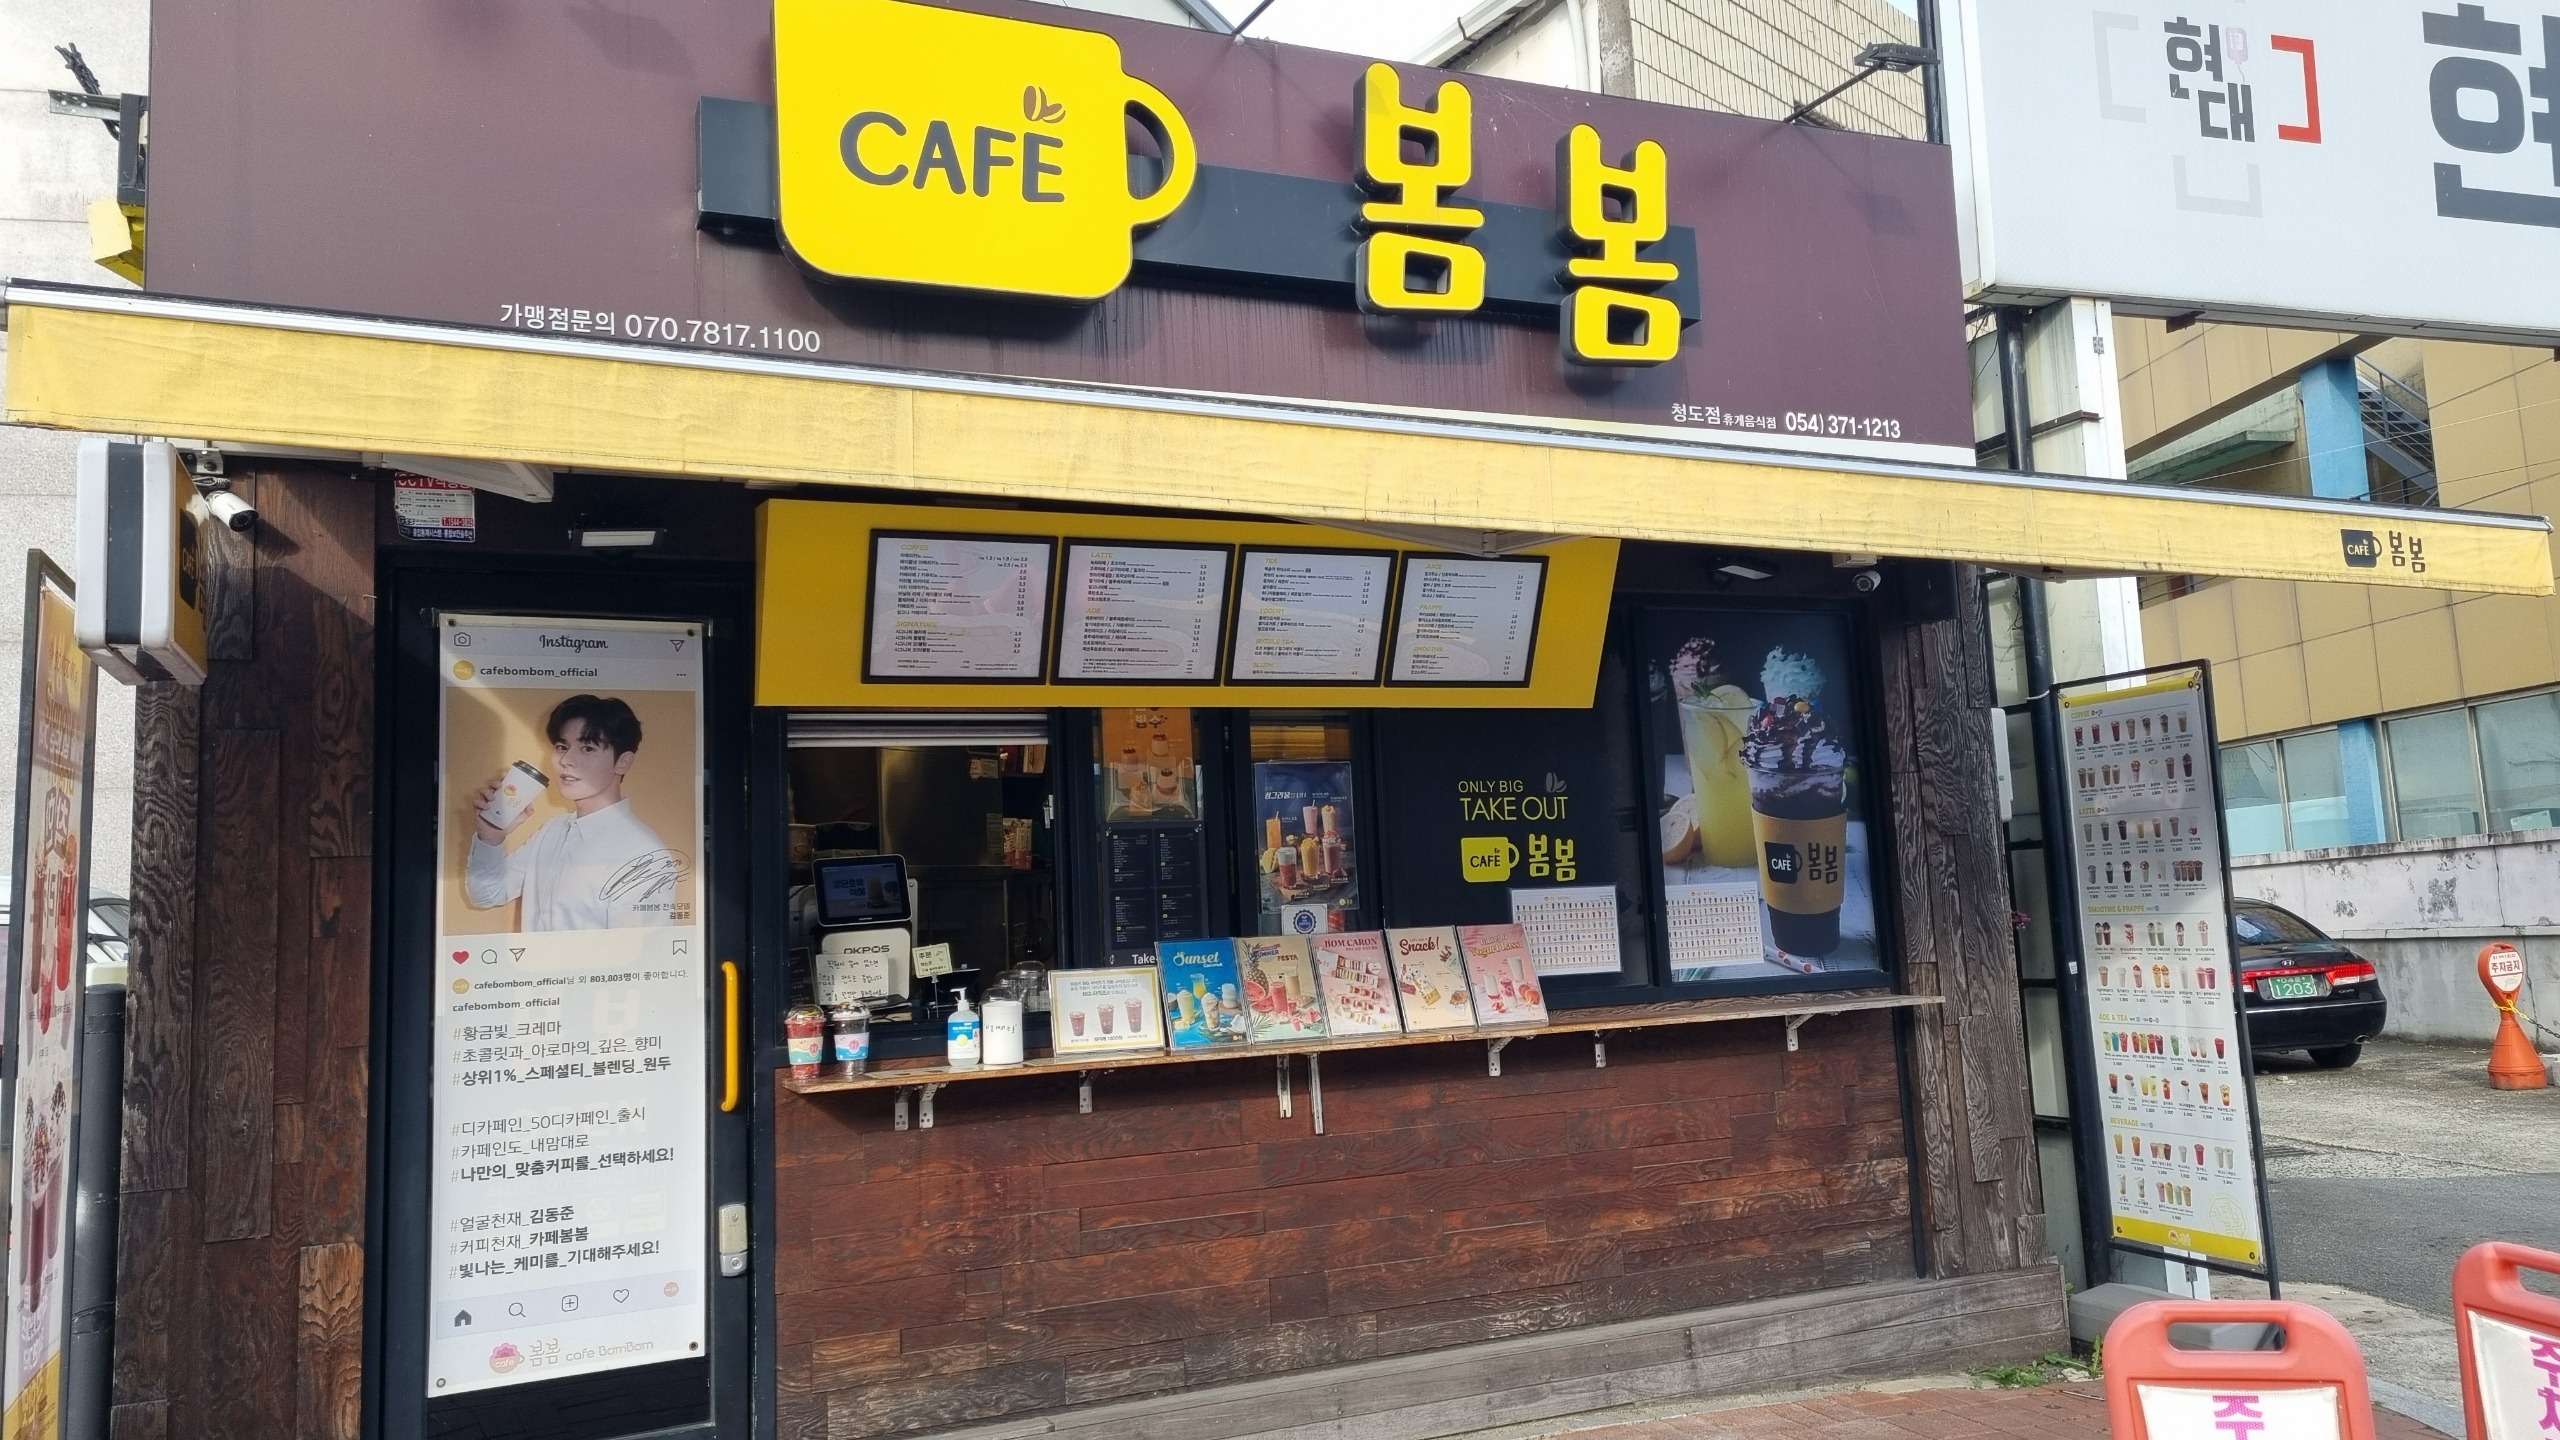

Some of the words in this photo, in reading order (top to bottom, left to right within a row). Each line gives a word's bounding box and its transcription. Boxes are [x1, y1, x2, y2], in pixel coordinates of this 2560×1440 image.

[2164, 16, 2255, 143] 현대
[839, 111, 1066, 203] CAFE
[1357, 61, 1682, 366] 봄봄
[500, 303, 616, 335] 가맹점문의
[625, 314, 821, 352] 070.7817.1100
[1671, 402, 1720, 424] 청도점
[1723, 413, 1777, 429] 휴게음식점
[2347, 544, 2370, 556] CAFE
[2388, 530, 2426, 574] 봄봄
[538, 634, 609, 653] Instagram
[480, 665, 598, 678] cafebombom_official
[1458, 780, 1495, 793] ONLY
[1499, 779, 1524, 793] BIG
[1460, 796, 1518, 822] TAKE
[1522, 795, 1569, 821] OUT
[1470, 854, 1501, 869] CAFE
[1528, 833, 1577, 882] 봄봄
[1771, 857, 1792, 872] CAFE
[1808, 841, 1838, 885] 봄봄
[1324, 939, 1346, 948] BOM
[1346, 937, 1378, 947] CARON
[1399, 936, 1440, 956] Snack!
[1172, 951, 1220, 967] Sunset
[1277, 954, 1299, 962] FESTA
[2491, 960, 2521, 973] 주차금지
[474, 975, 575, 990] cafebombom_official님
[2275, 982, 2314, 997] 1203
[452, 997, 561, 1013] cafebombom_official
[453, 1020, 562, 1042] #황금빛_크레마
[453, 1035, 662, 1064] #초콜릿과_아로마의_깊은_향미
[451, 1106, 646, 1137] #디카페인_50디카페인_출시
[2110, 1117, 2139, 1127] BEVERAGE
[451, 1134, 590, 1161] #카페인도_내맘대로
[451, 1147, 675, 1183] #나만의_맞춤커피를_선택하세요!
[450, 1205, 575, 1233] #얼굴천재_김동준
[449, 1226, 590, 1256] #커피천재_카페봄봄
[449, 1240, 661, 1280] #빛나는_케미를_기대해주세요!
[565, 1347, 596, 1362] cafe
